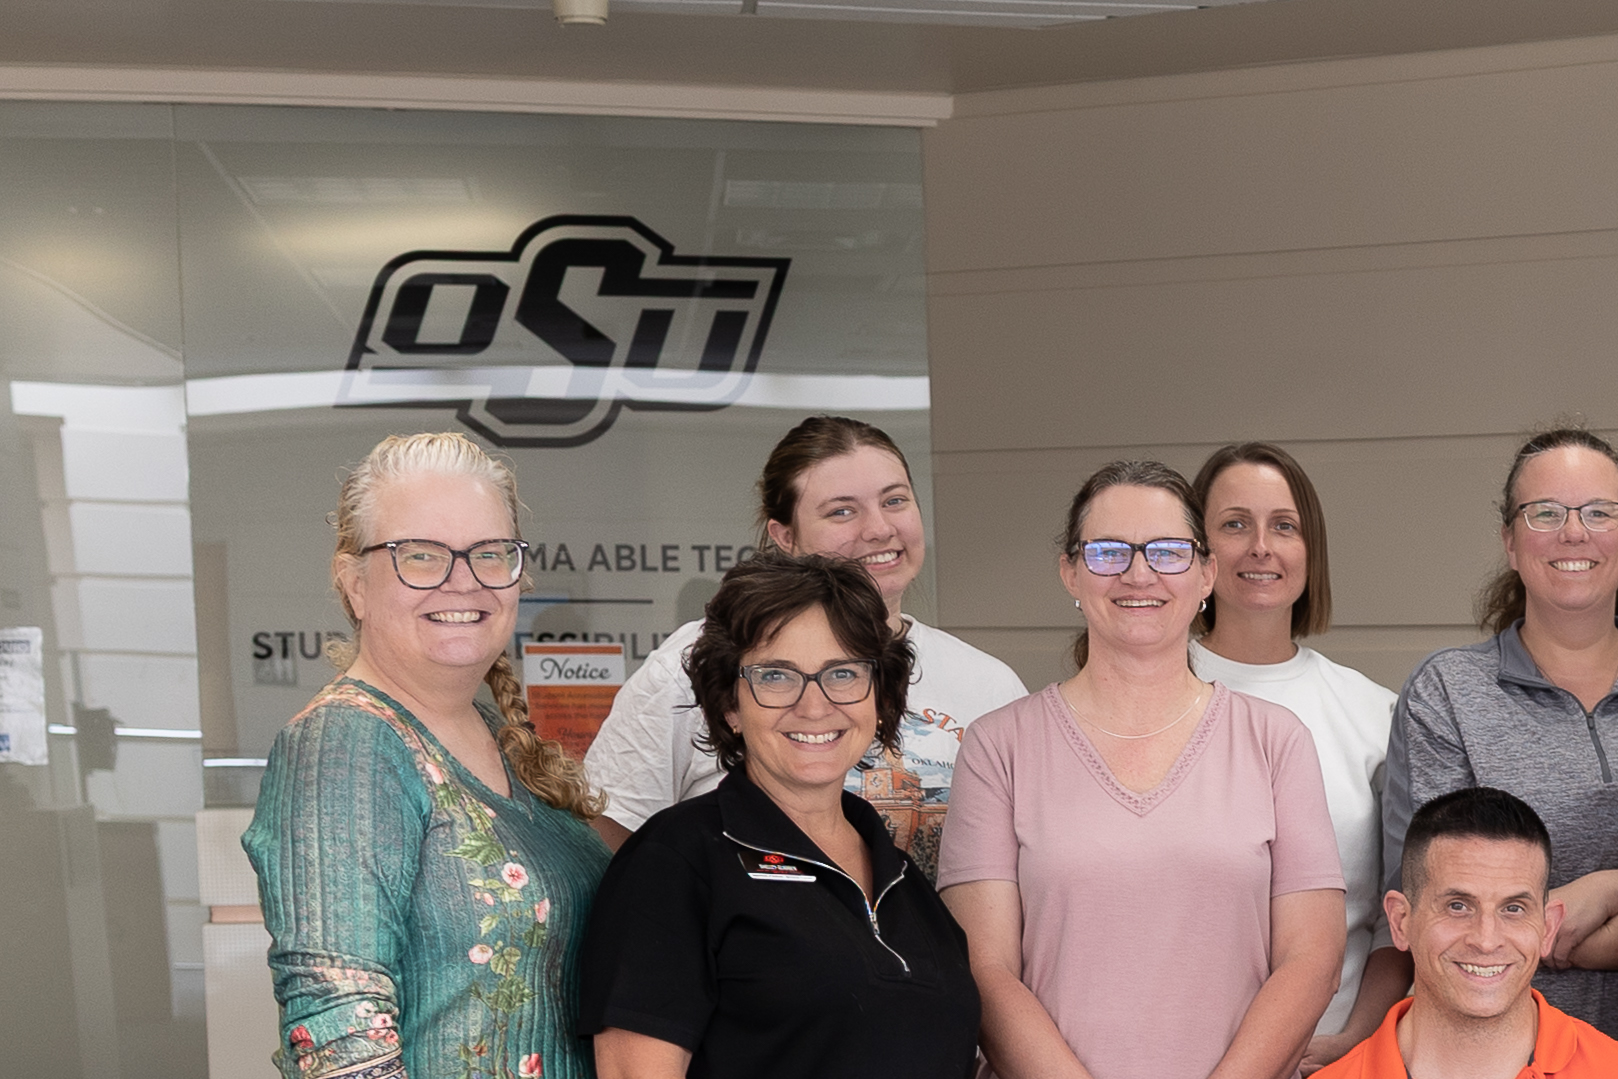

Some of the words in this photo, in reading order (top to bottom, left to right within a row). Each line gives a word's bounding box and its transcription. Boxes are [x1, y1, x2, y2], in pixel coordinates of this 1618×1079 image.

[345, 222, 782, 440] OSU
[587, 544, 680, 572] ABLE
[540, 657, 611, 680] Notice
